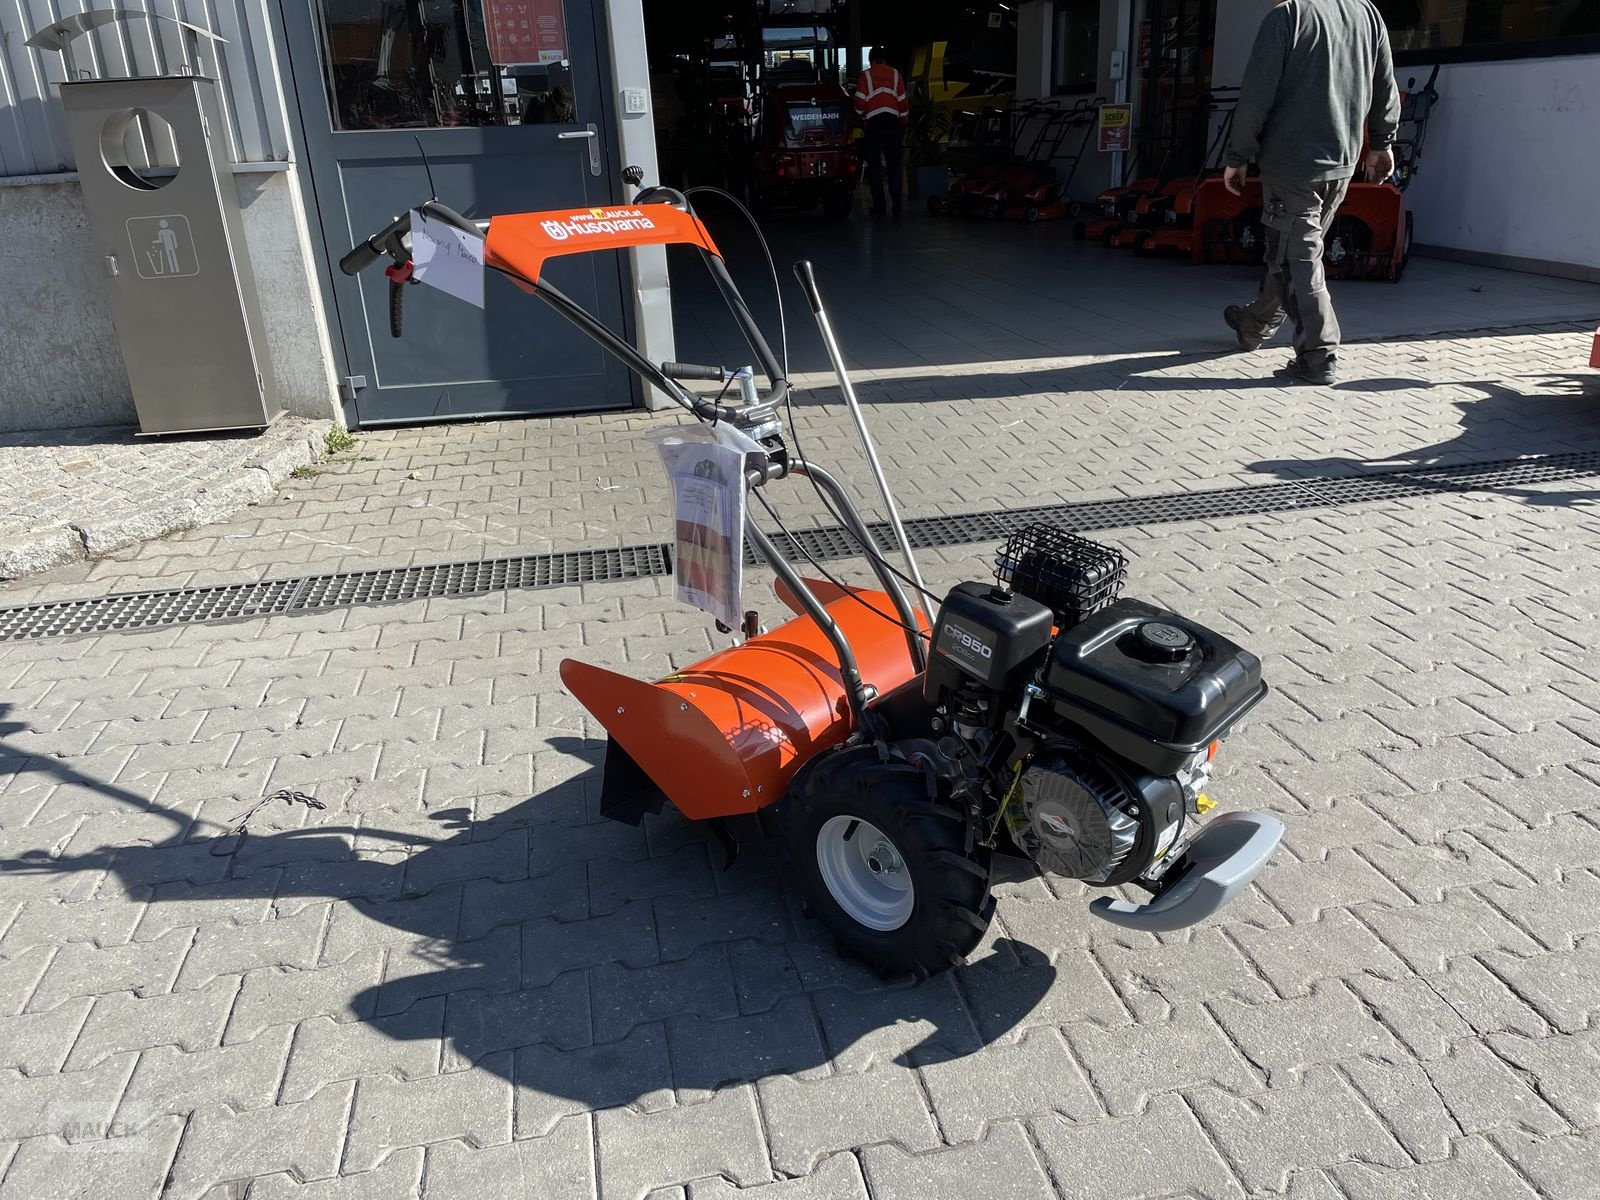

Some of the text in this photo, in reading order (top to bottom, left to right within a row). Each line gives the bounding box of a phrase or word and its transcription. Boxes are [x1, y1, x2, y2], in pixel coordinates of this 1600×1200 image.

[791, 112, 840, 121] WEIDEMANN
[569, 208, 644, 222] www.MAUCH.at
[561, 217, 656, 235] Husqvarna
[944, 624, 993, 659] CR950
[952, 643, 976, 661] 208cc
